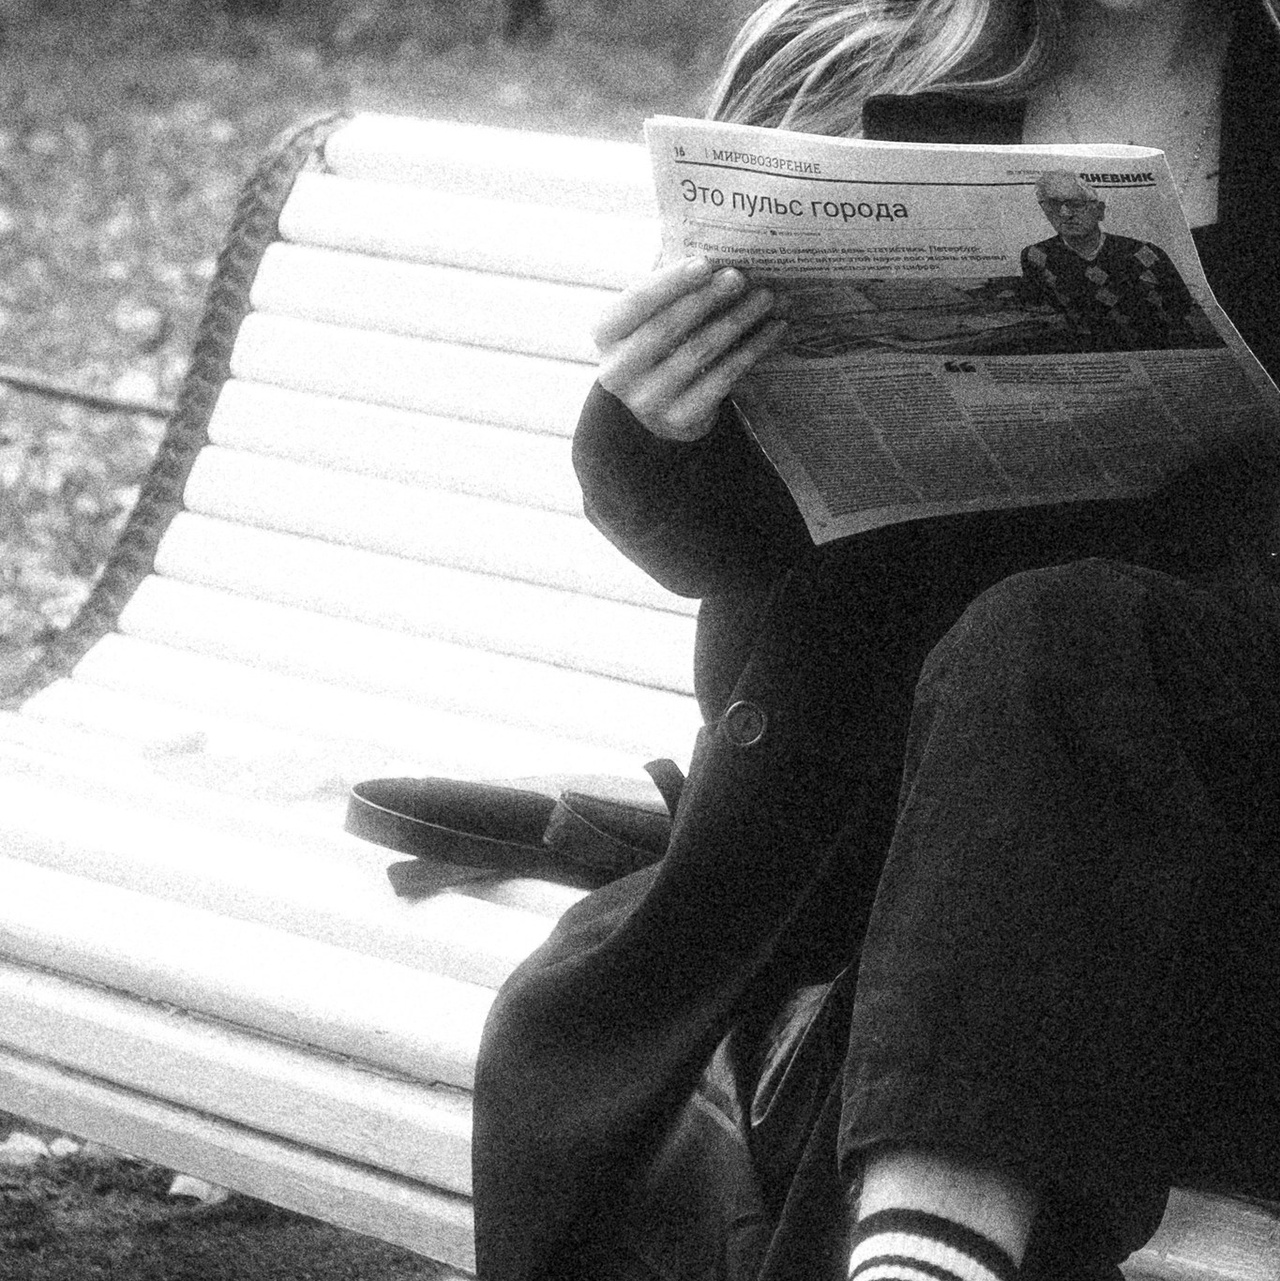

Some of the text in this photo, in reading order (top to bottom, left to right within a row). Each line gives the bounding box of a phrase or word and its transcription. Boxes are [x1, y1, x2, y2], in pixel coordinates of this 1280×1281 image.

[713, 149, 821, 174] МИРОВОЗЗРЕНИЕ
[1080, 172, 1154, 183] ДНЕВНИК
[681, 179, 909, 222] Это пульс города
